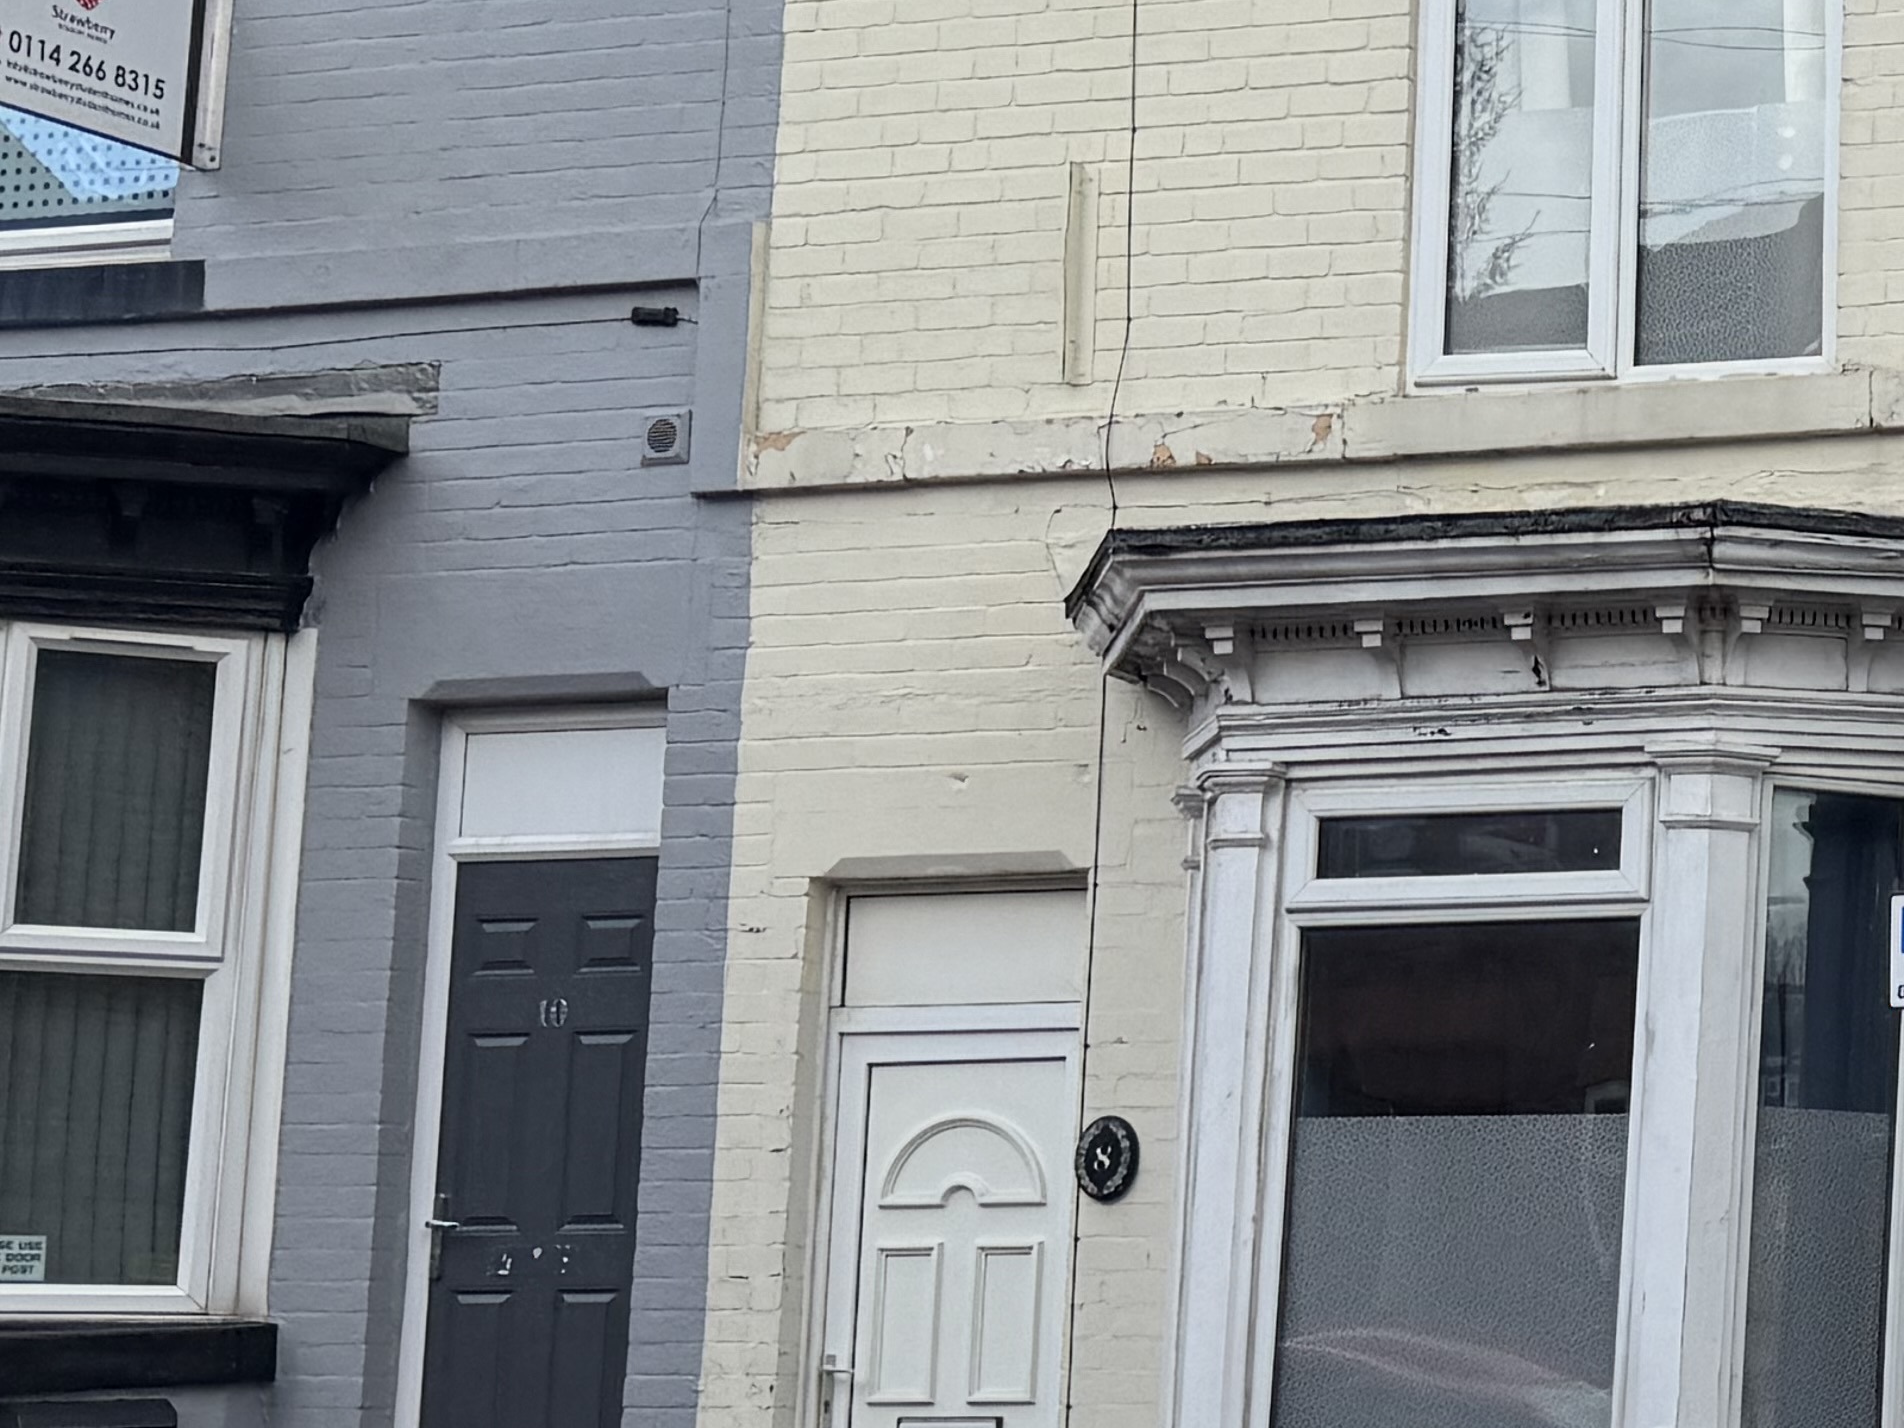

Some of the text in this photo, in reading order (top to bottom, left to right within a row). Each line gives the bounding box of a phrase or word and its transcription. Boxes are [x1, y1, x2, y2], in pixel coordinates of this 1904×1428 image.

[9, 30, 61, 66] 0114
[68, 50, 107, 81] 266
[114, 65, 165, 100] 8315
[1093, 1145, 1112, 1172] 8
